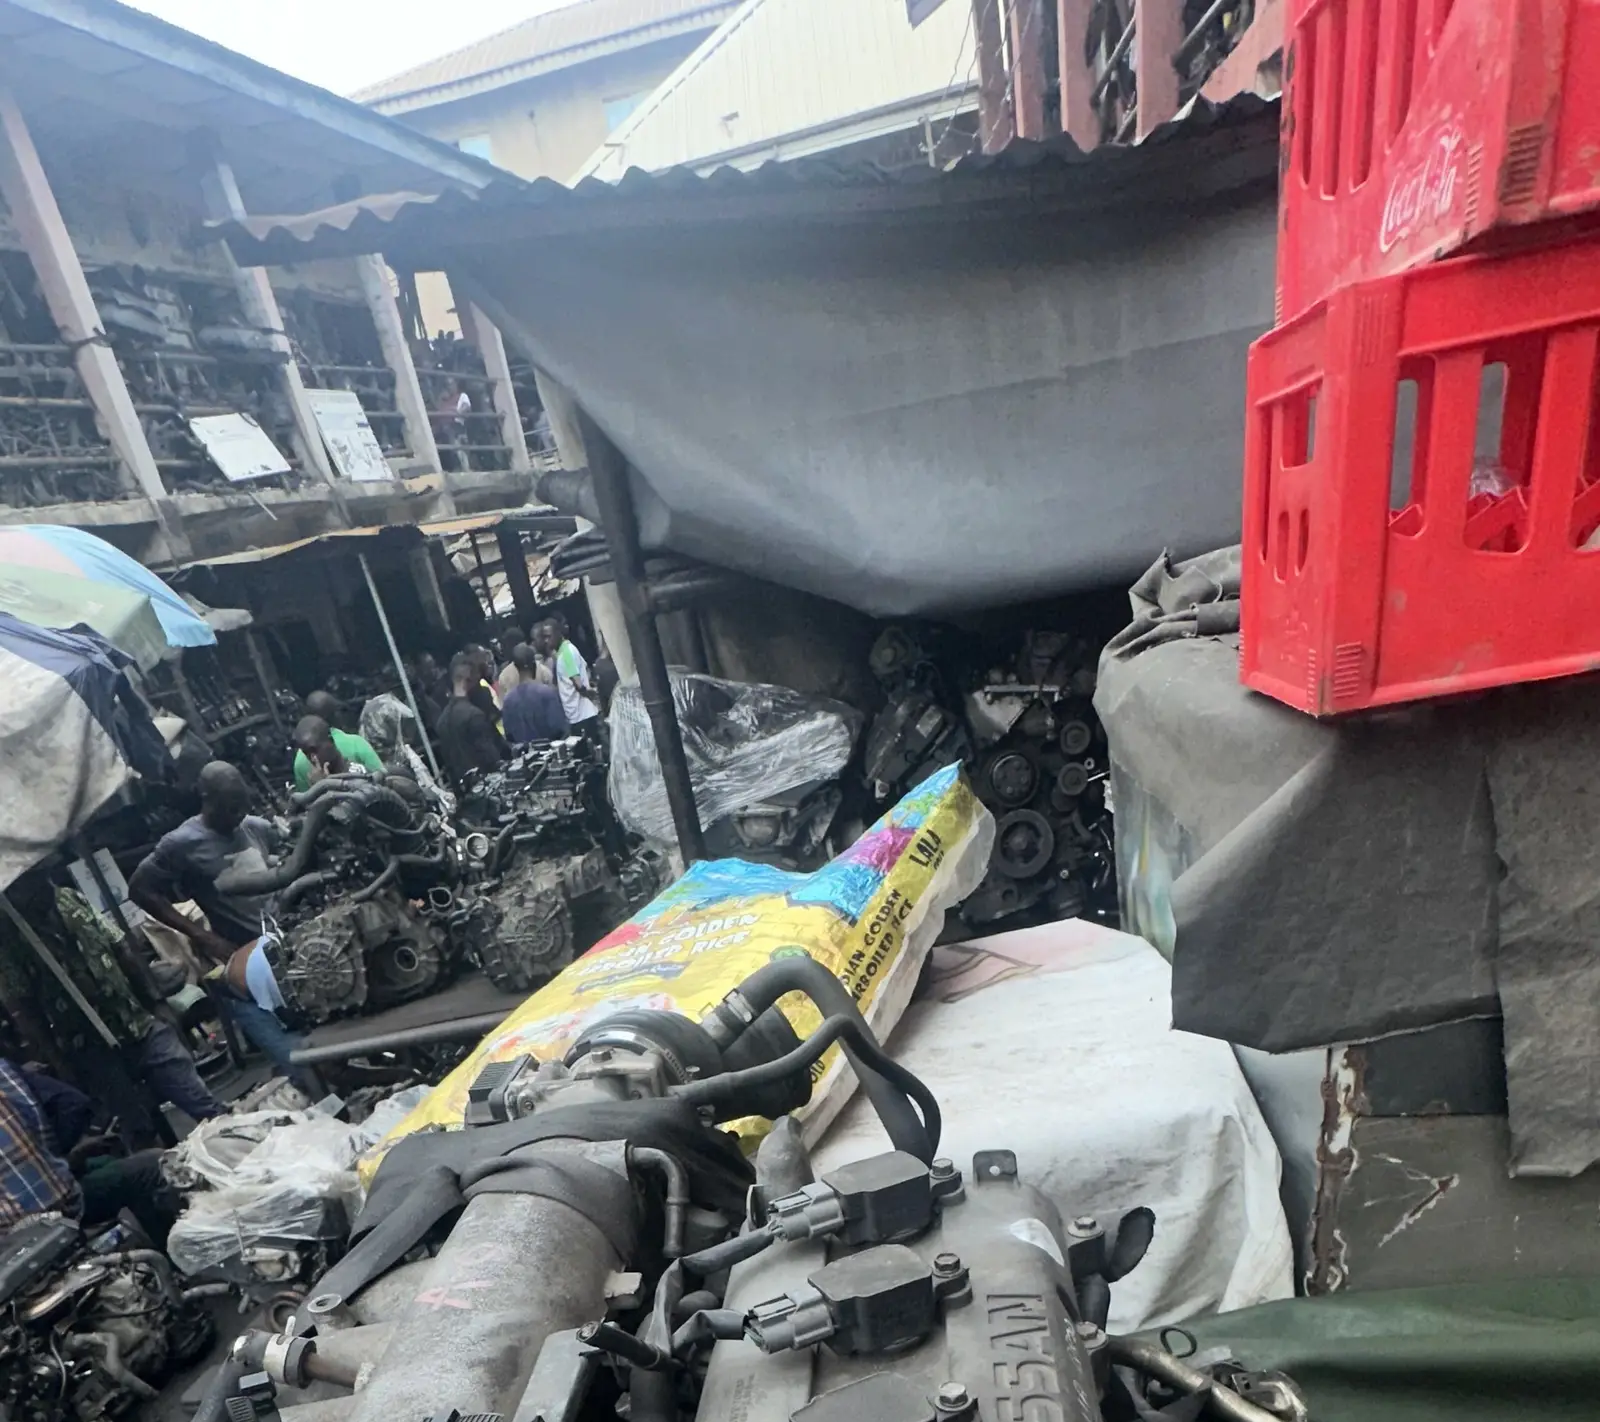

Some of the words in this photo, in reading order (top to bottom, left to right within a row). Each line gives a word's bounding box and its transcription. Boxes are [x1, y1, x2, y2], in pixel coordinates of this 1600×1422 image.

[909, 829, 941, 867] LALA
[659, 914, 760, 943] GOLDEN
[691, 931, 751, 955] RICE
[840, 950, 866, 986] DIAN
[864, 889, 901, 946] GOLDEN
